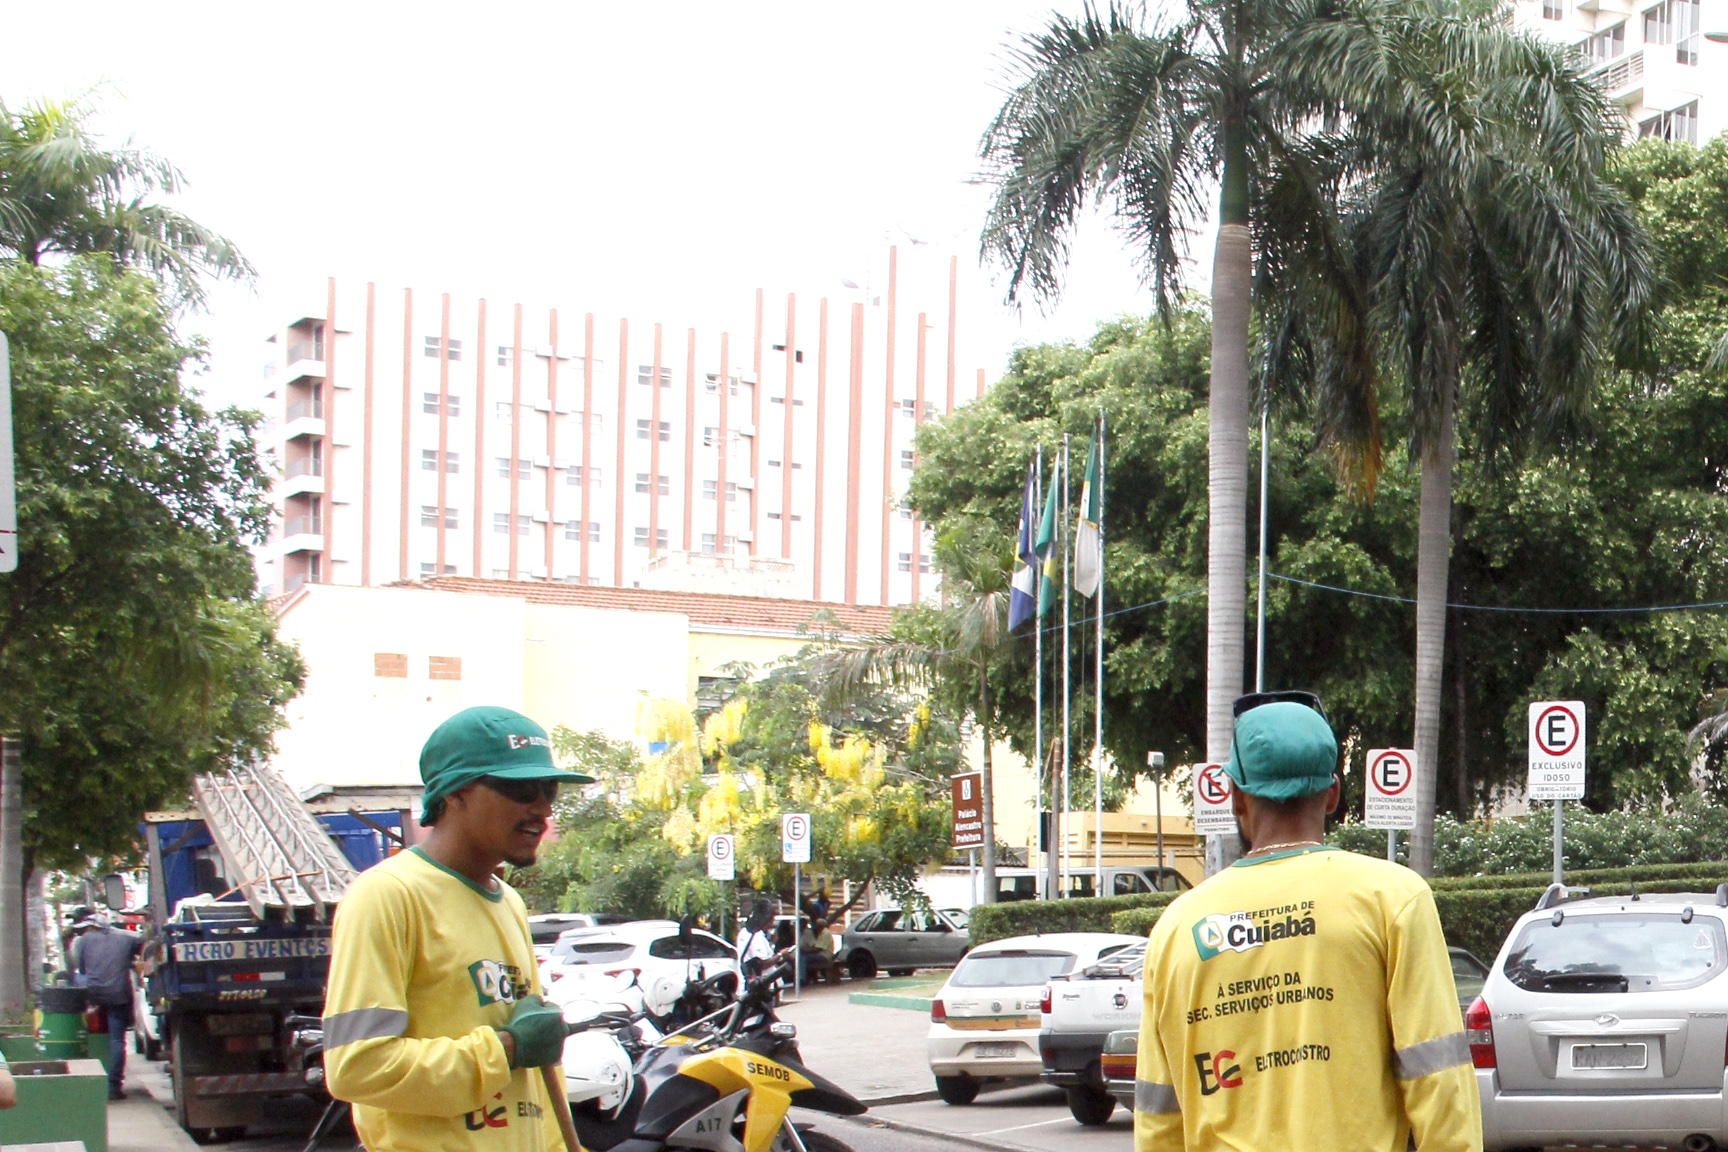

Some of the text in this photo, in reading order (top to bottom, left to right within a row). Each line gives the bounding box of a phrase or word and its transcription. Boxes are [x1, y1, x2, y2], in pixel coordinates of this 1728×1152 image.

[1548, 715, 1566, 746] E
[1383, 759, 1400, 787] E
[1532, 761, 1583, 770] EXCLUSIVO
[1543, 773, 1570, 781] IDOSO
[792, 820, 801, 836] E
[716, 841, 725, 856] E
[1229, 900, 1315, 922] PREFEITURA DE
[1227, 910, 1316, 947] Cuiabá
[1228, 974, 1280, 996] SERVIÇO
[1284, 971, 1302, 986] DA
[1186, 986, 1334, 1024] SEC. SERVIÇOS URBANOS
[747, 1061, 791, 1082] SEMOB
[1194, 1049, 1244, 1096] EC
[695, 1117, 722, 1133] A17
